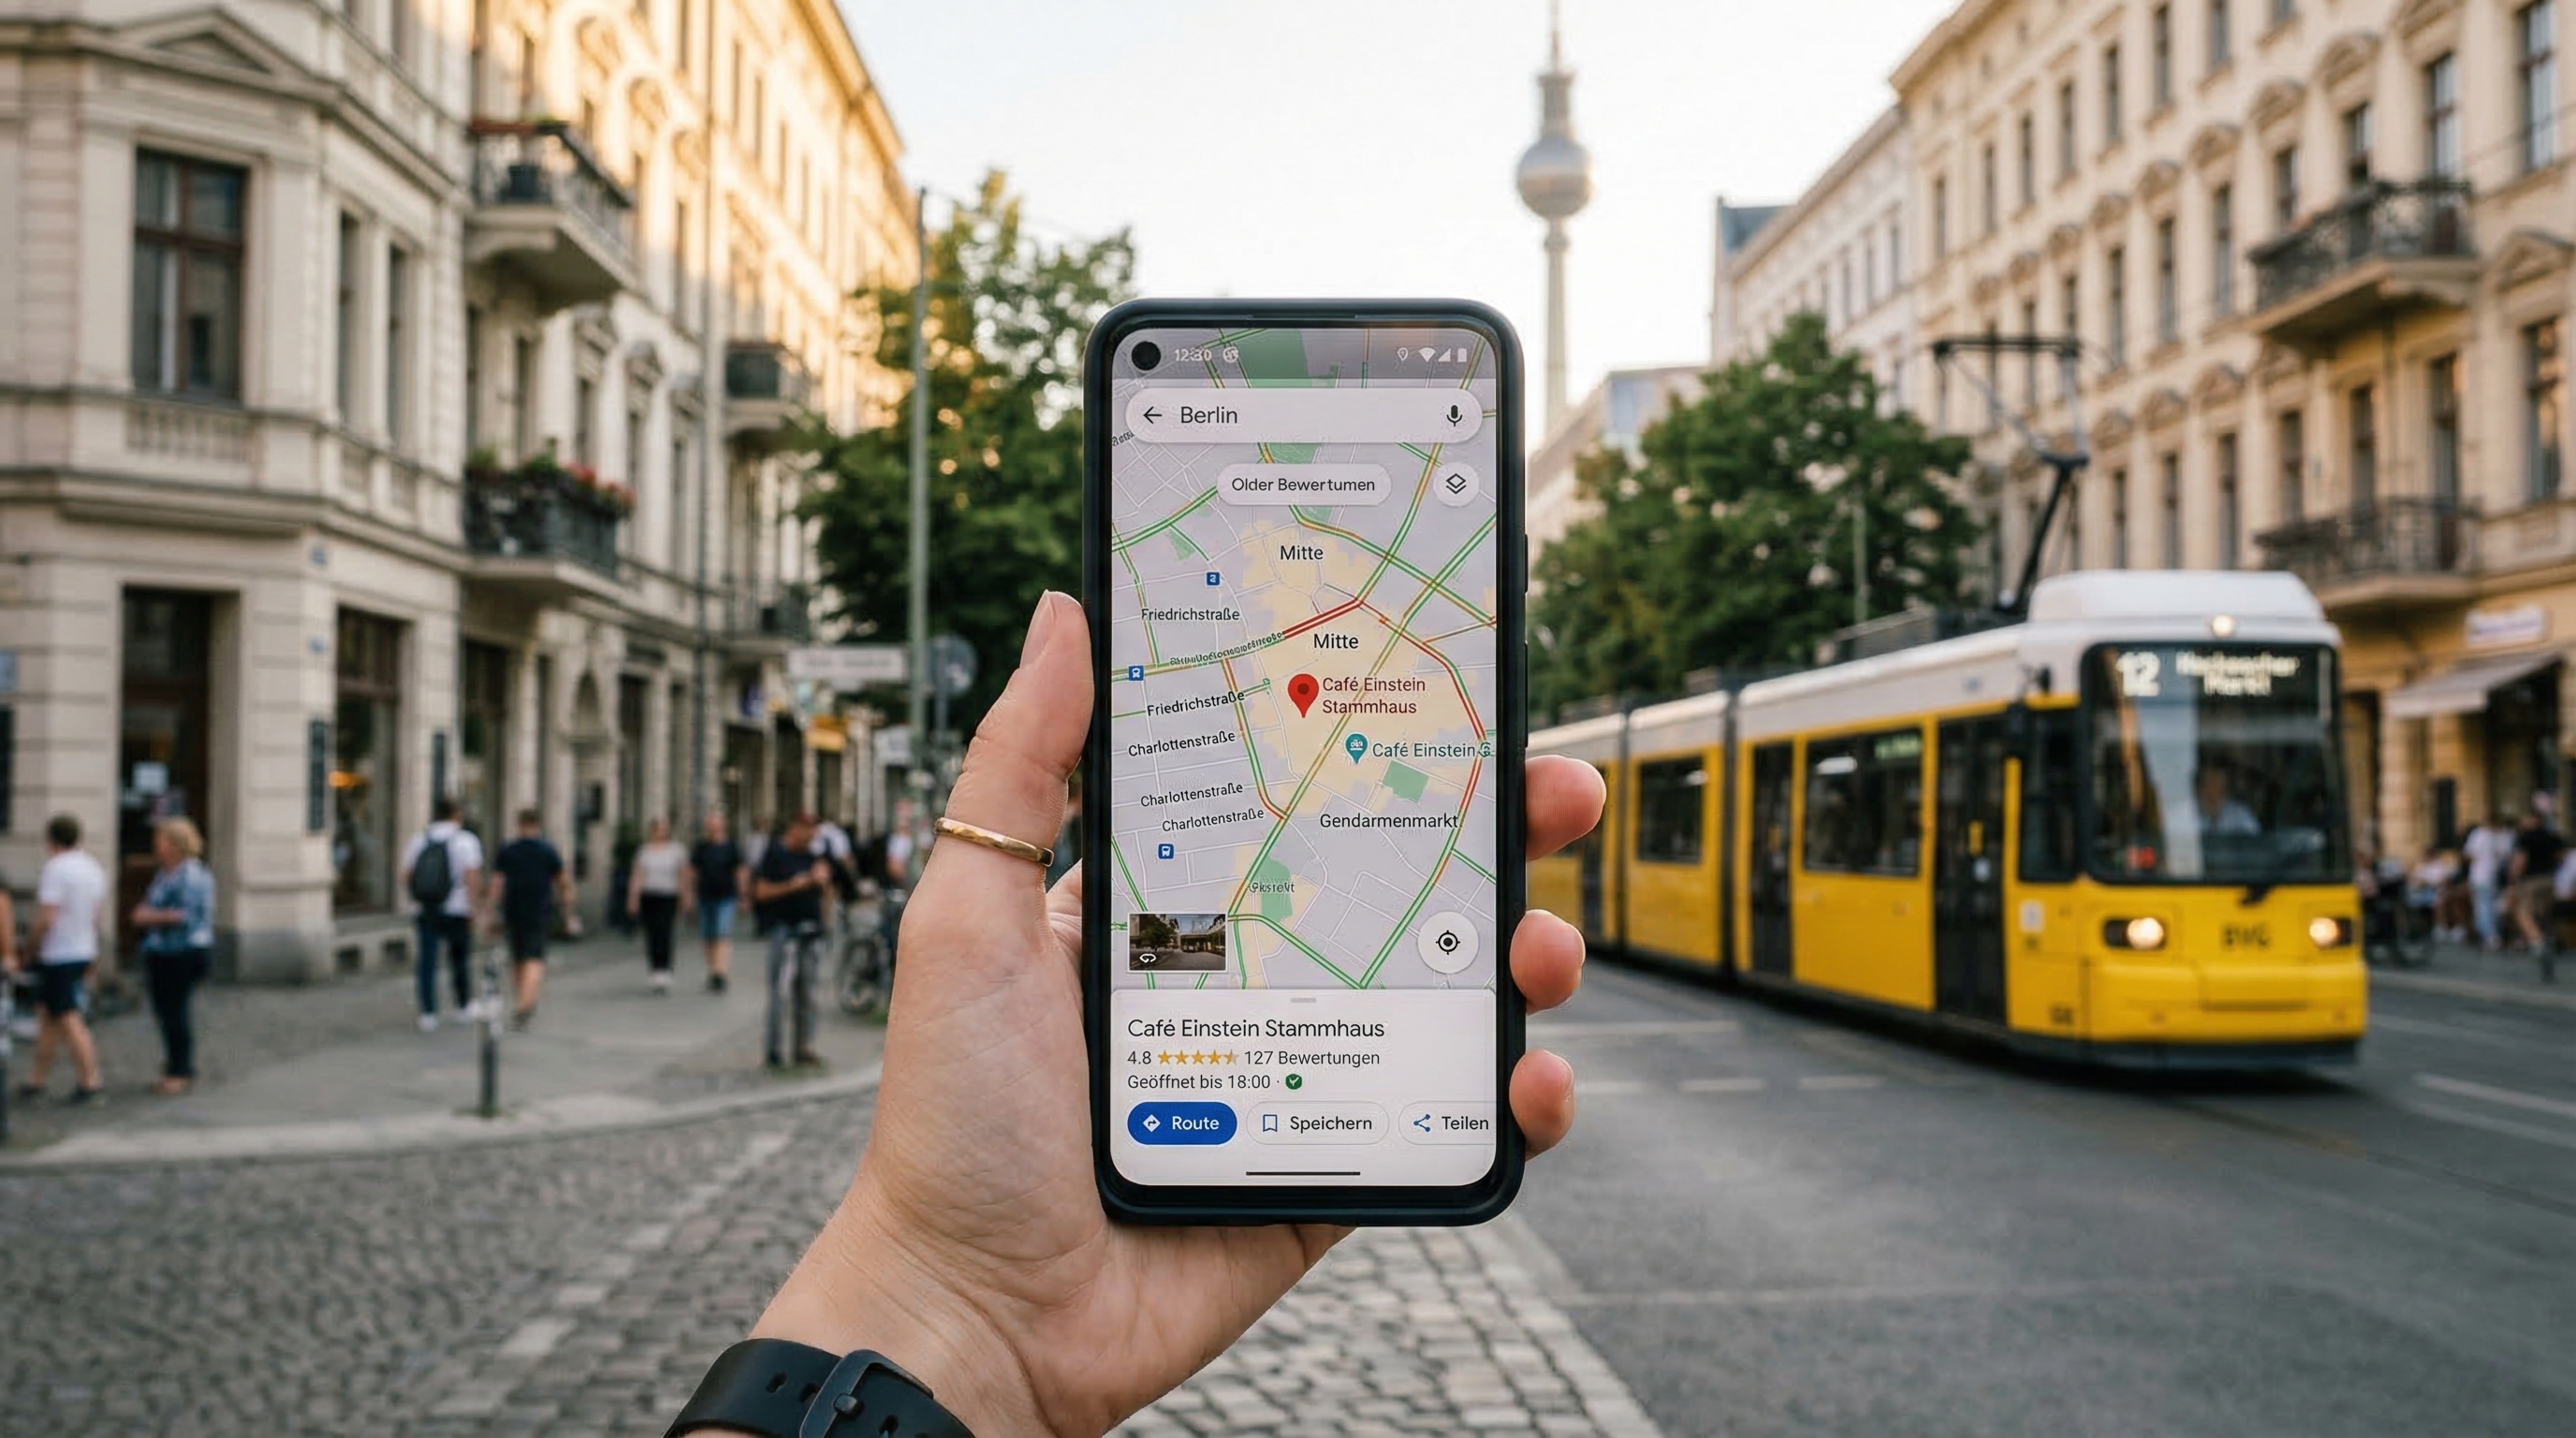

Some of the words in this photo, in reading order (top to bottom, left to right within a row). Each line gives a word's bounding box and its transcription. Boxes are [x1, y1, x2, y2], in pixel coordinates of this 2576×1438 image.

[1180, 405, 1237, 424] Berlin
[1231, 477, 1274, 492] Older
[1278, 477, 1375, 492] Bewertumen
[1280, 545, 1324, 561] Mitte
[1141, 608, 1240, 621] Friedrichstraße
[1313, 633, 1359, 650] Mitte
[1322, 676, 1359, 693] Café
[1364, 676, 1426, 693] Einstein
[1147, 691, 1246, 717] Friedrichstraße
[1322, 698, 1417, 714] Stammhaus
[1128, 730, 1236, 756] Charlottenstraße
[1372, 741, 1409, 758] Café
[1413, 741, 1476, 758] Einstein
[1140, 783, 1243, 807] Charlottenstraße
[1162, 808, 1265, 832] Charlottenstraße
[1320, 813, 1458, 829] Gendarmenmarkt
[1127, 1019, 1176, 1037] Café
[1181, 1019, 1260, 1037] Einstein
[1265, 1019, 1385, 1037] Stammhaus
[1127, 1050, 1151, 1065] 4.8
[1244, 1050, 1274, 1065] 127
[1279, 1050, 1380, 1068] Bewertungen
[1127, 1074, 1195, 1089] Geöffnet
[1200, 1074, 1222, 1089] bis
[1227, 1074, 1270, 1089] 18:00
[1172, 1115, 1220, 1131] Route
[1290, 1115, 1372, 1135] Speichern
[1441, 1115, 1489, 1131] Teilen
